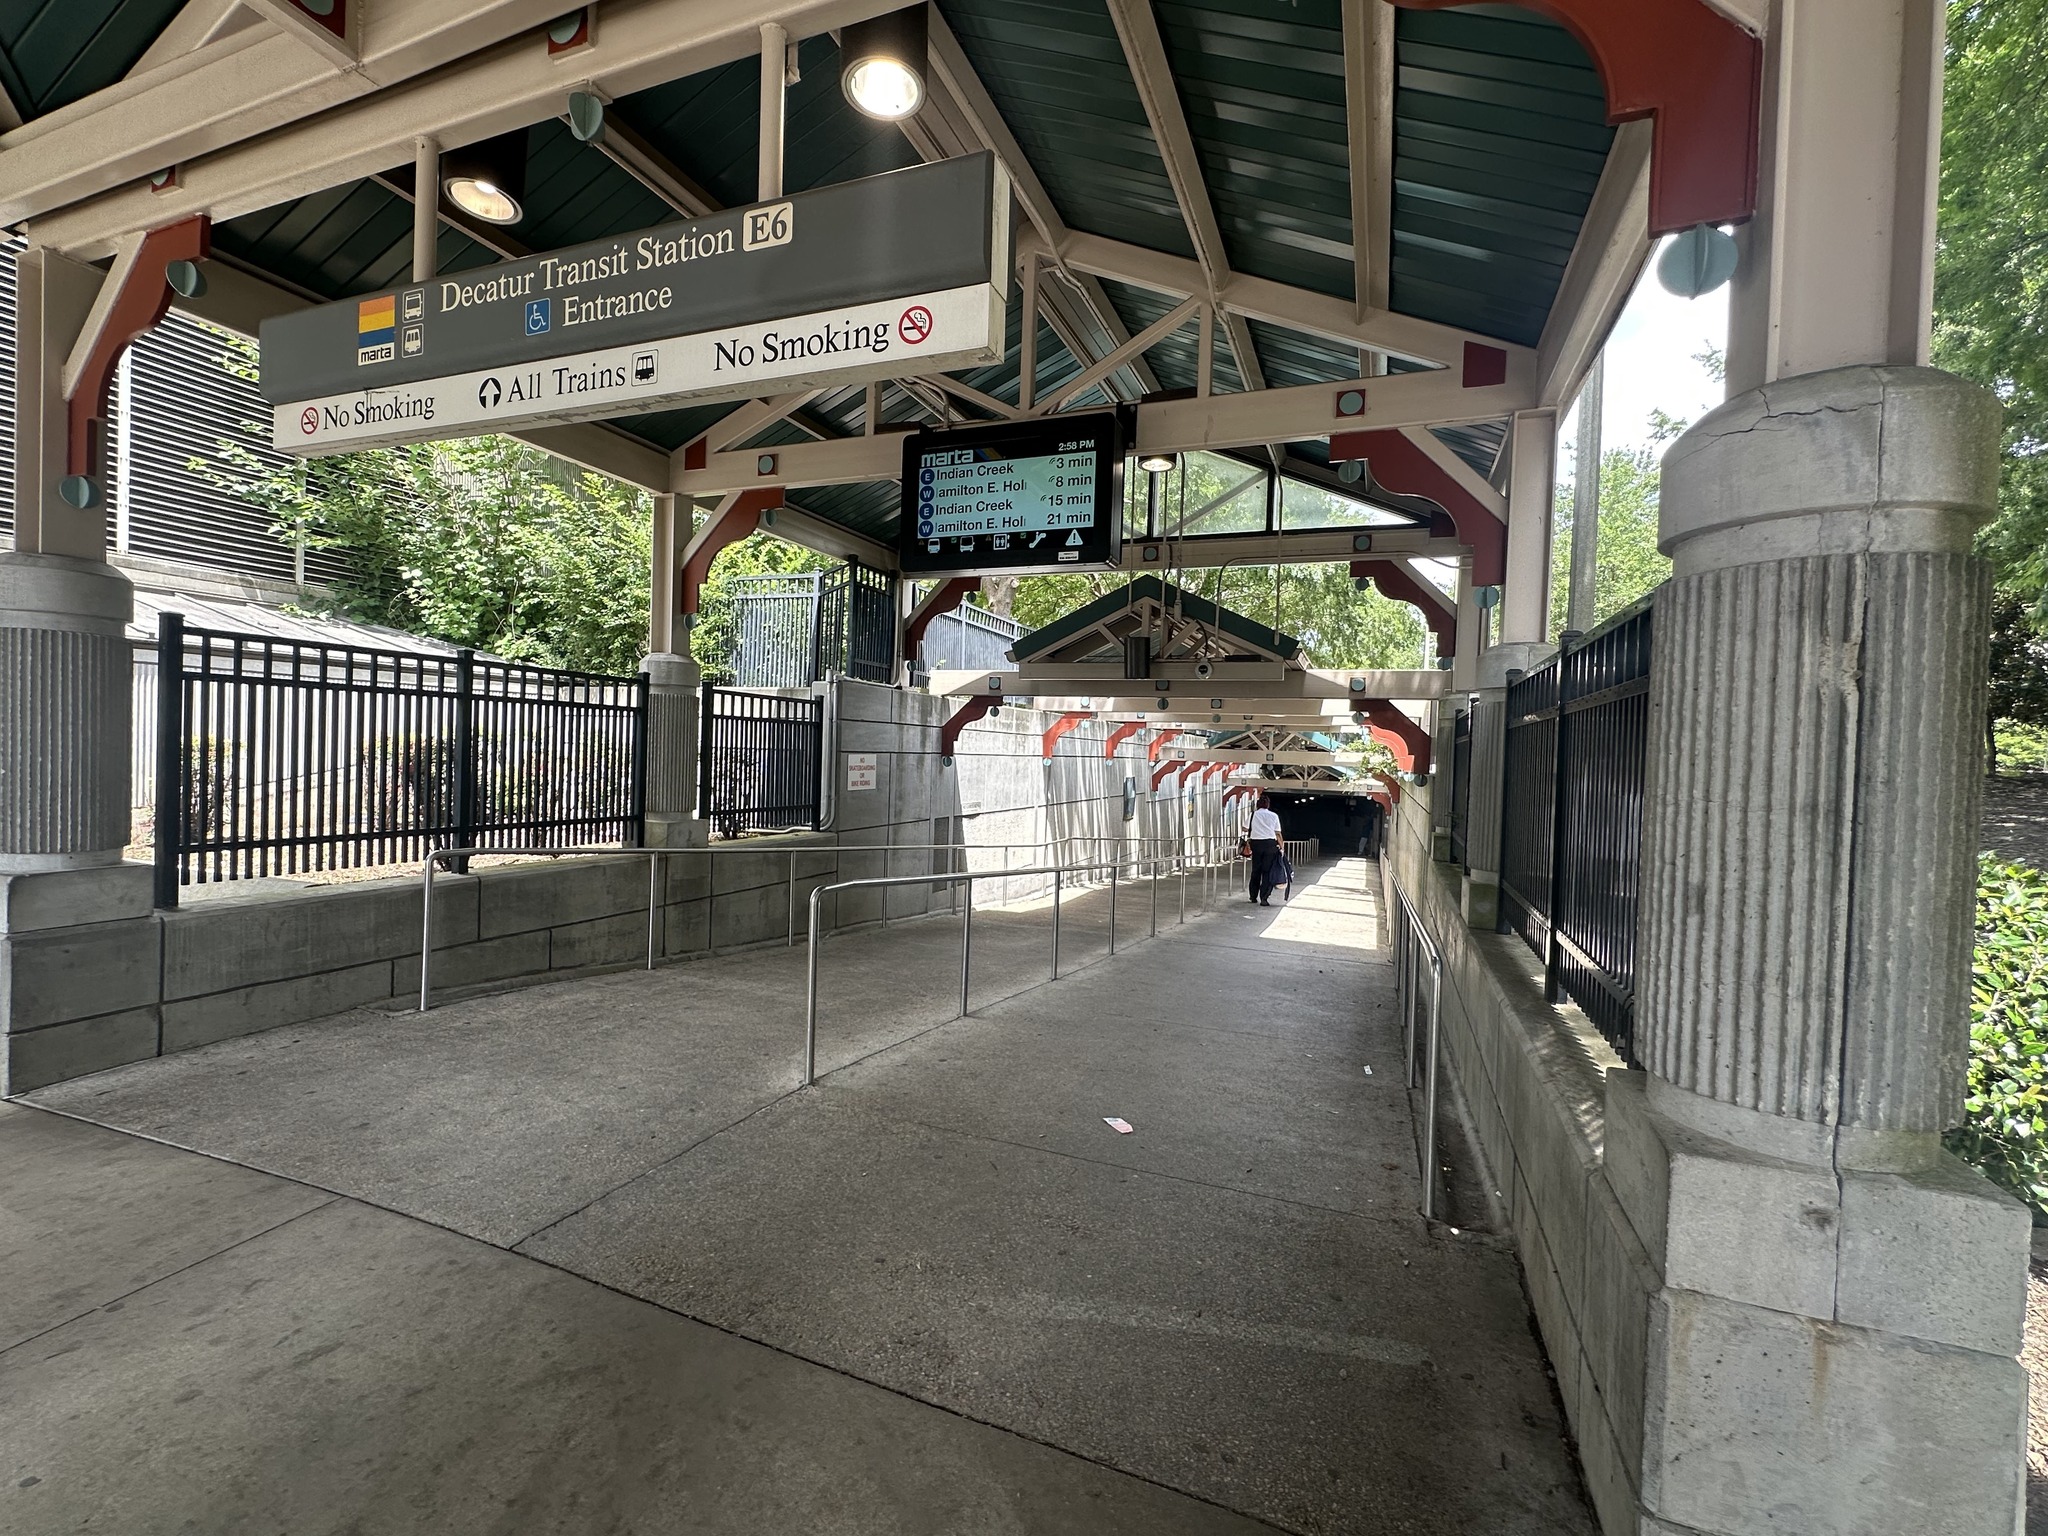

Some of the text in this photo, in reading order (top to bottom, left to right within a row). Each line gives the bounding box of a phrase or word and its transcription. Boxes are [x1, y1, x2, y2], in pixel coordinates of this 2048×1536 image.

[440, 207, 788, 313] Decatur Transit Station E6
[562, 286, 673, 327] Entrance
[713, 320, 890, 371] No Smoking
[360, 346, 392, 363] marta
[507, 362, 627, 404] All Trains
[323, 393, 435, 430] No Smoking
[1058, 440, 1095, 451] 2:58 PM
[921, 450, 974, 467] marta
[1056, 455, 1093, 469] 3 min
[936, 468, 973, 481] Indian
[977, 462, 1015, 477] Creek
[1055, 473, 1092, 487] 8 min
[987, 481, 999, 493] E.
[935, 502, 972, 516] Indian
[976, 498, 1013, 513] Creek
[1048, 492, 1092, 506] 15 min
[986, 517, 998, 529] E.
[1047, 511, 1091, 525] 21 min
